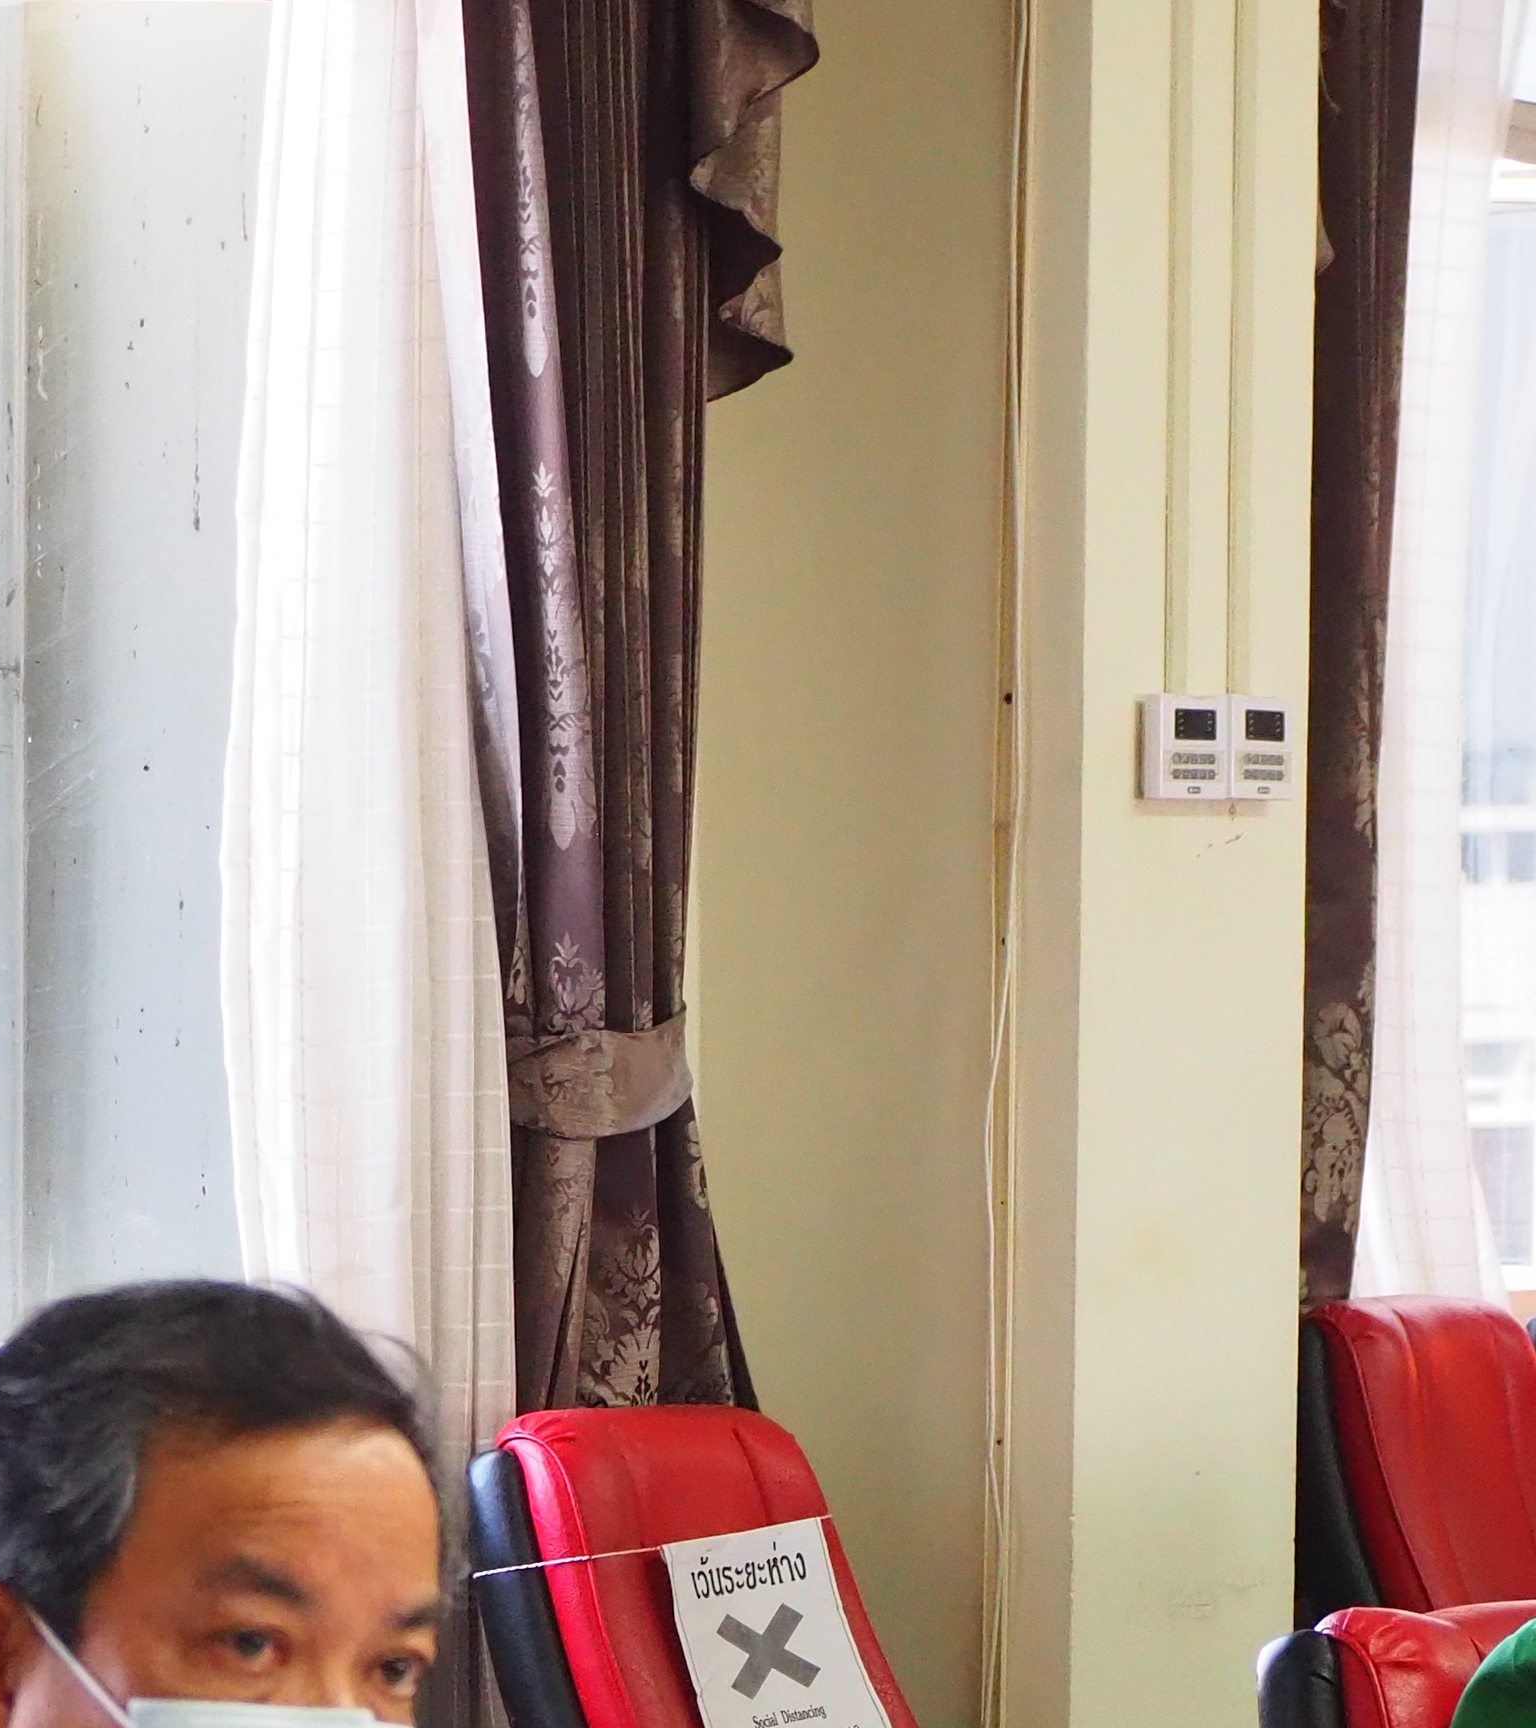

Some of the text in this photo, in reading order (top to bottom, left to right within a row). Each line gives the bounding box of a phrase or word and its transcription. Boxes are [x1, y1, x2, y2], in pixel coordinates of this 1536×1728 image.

[690, 1541, 807, 1600] เว้นระยะห่าง
[780, 1704, 827, 1725] Distancing
